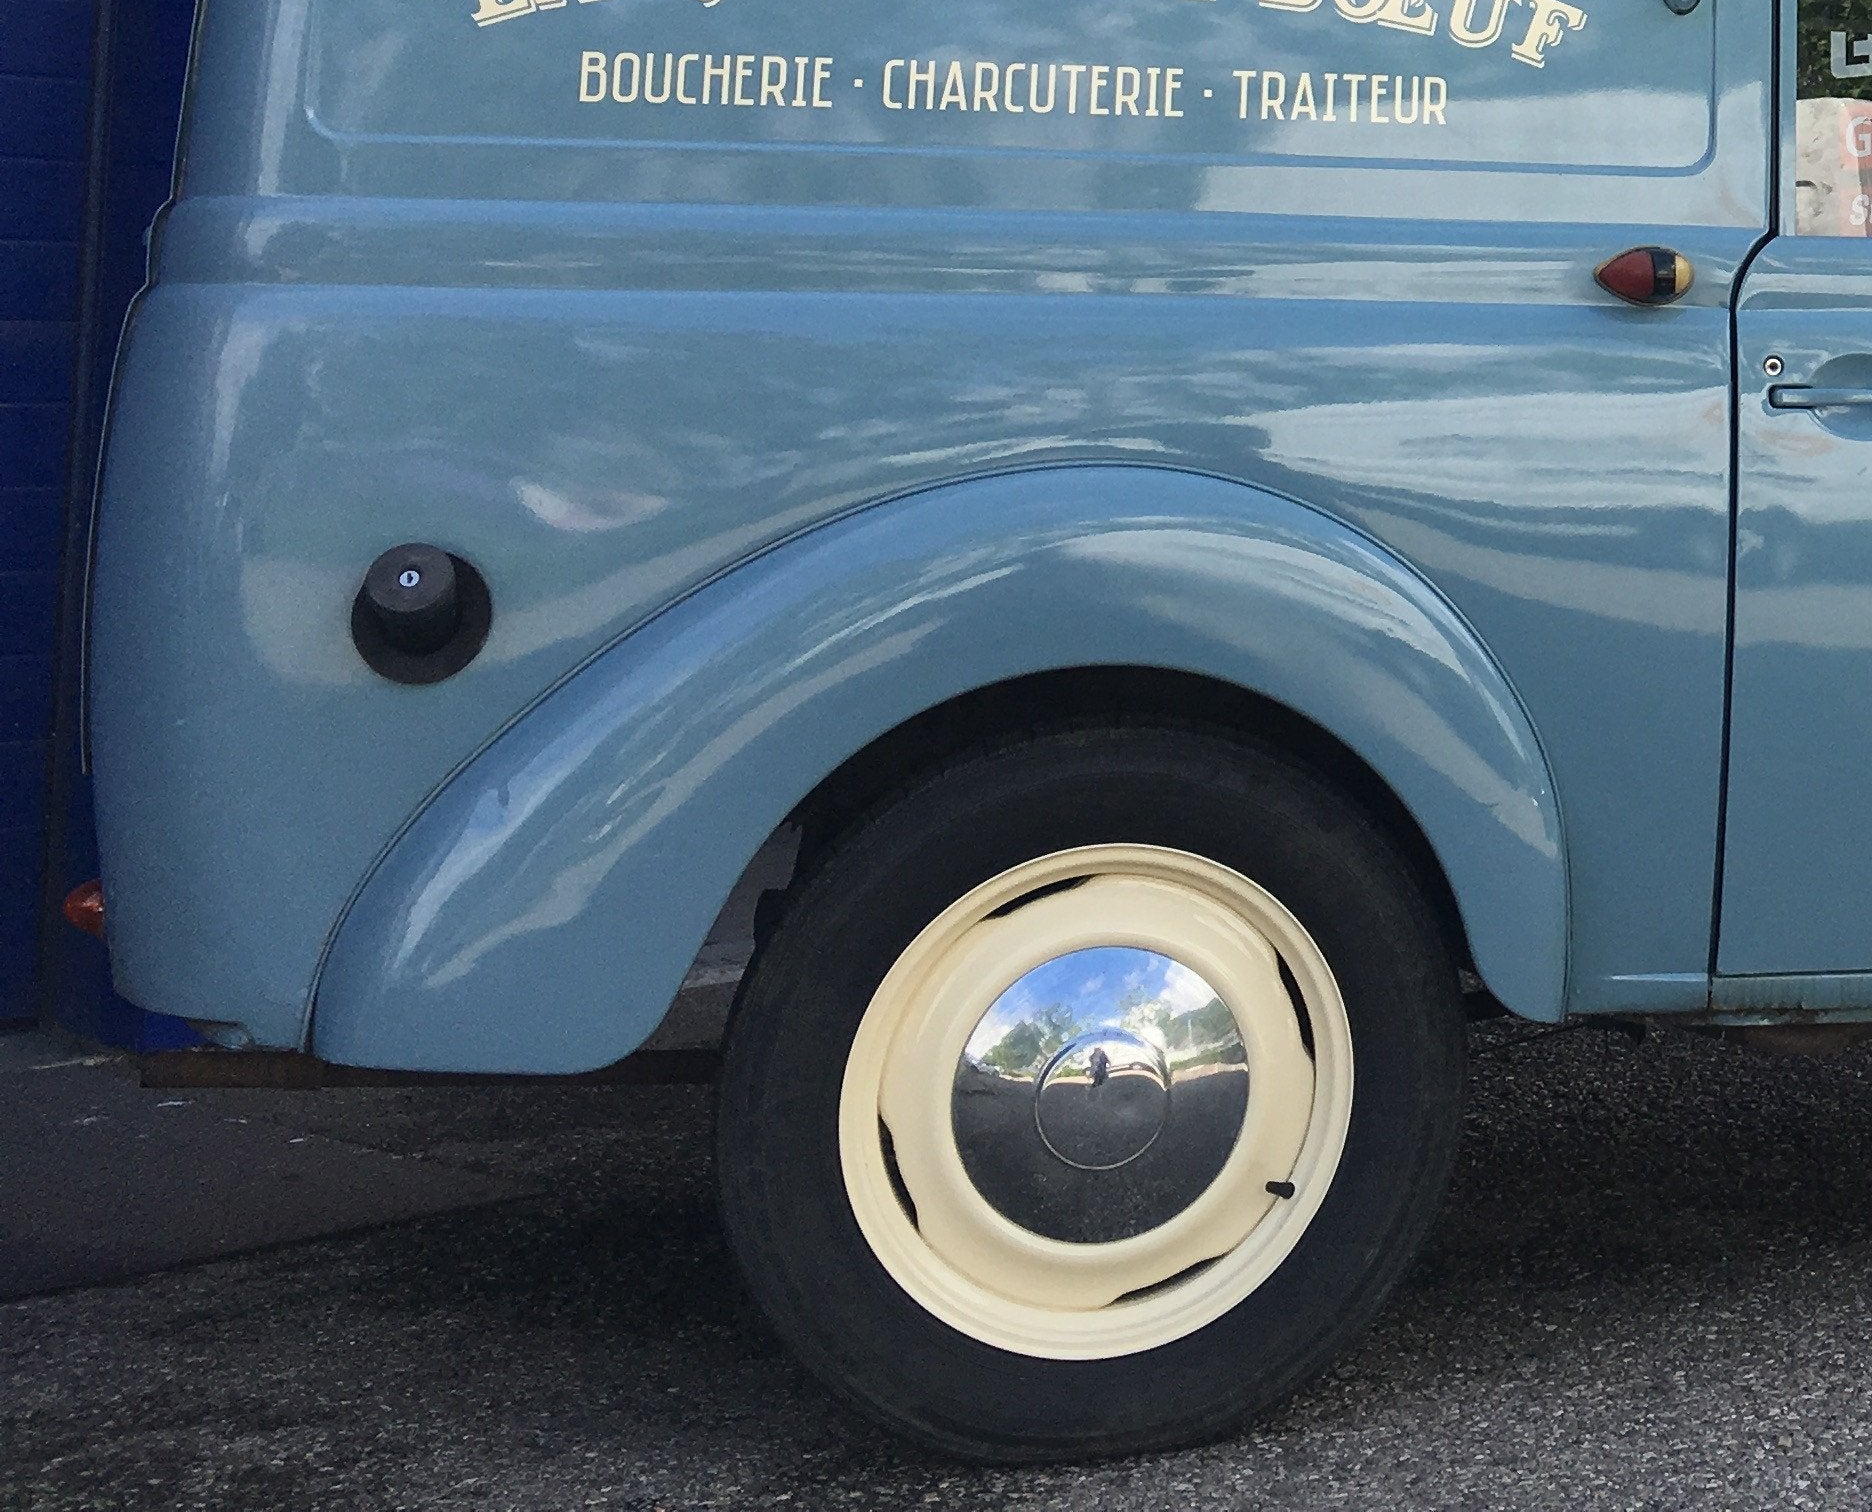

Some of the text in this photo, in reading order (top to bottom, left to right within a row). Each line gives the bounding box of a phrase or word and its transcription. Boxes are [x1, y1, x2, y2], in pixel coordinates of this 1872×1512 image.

[578, 50, 833, 109] BOUCHERIE
[882, 58, 1185, 119] CHARCUTERIE
[1232, 69, 1448, 126] TRAITEUR
